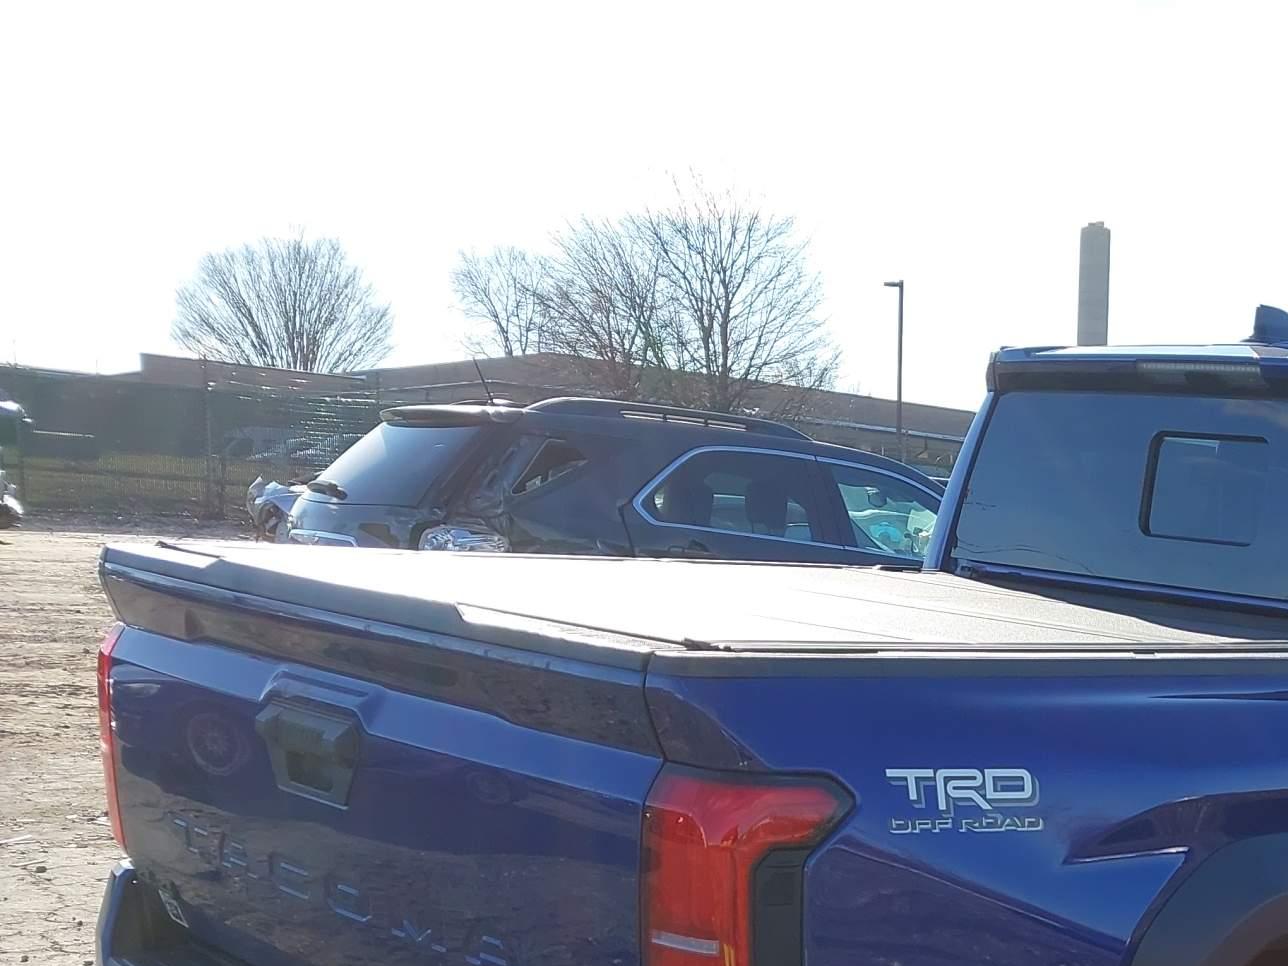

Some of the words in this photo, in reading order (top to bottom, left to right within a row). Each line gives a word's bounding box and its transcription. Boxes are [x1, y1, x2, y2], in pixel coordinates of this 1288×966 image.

[885, 768, 1037, 813] TRD
[890, 817, 954, 834] OFF
[958, 815, 1044, 834] ROAD
